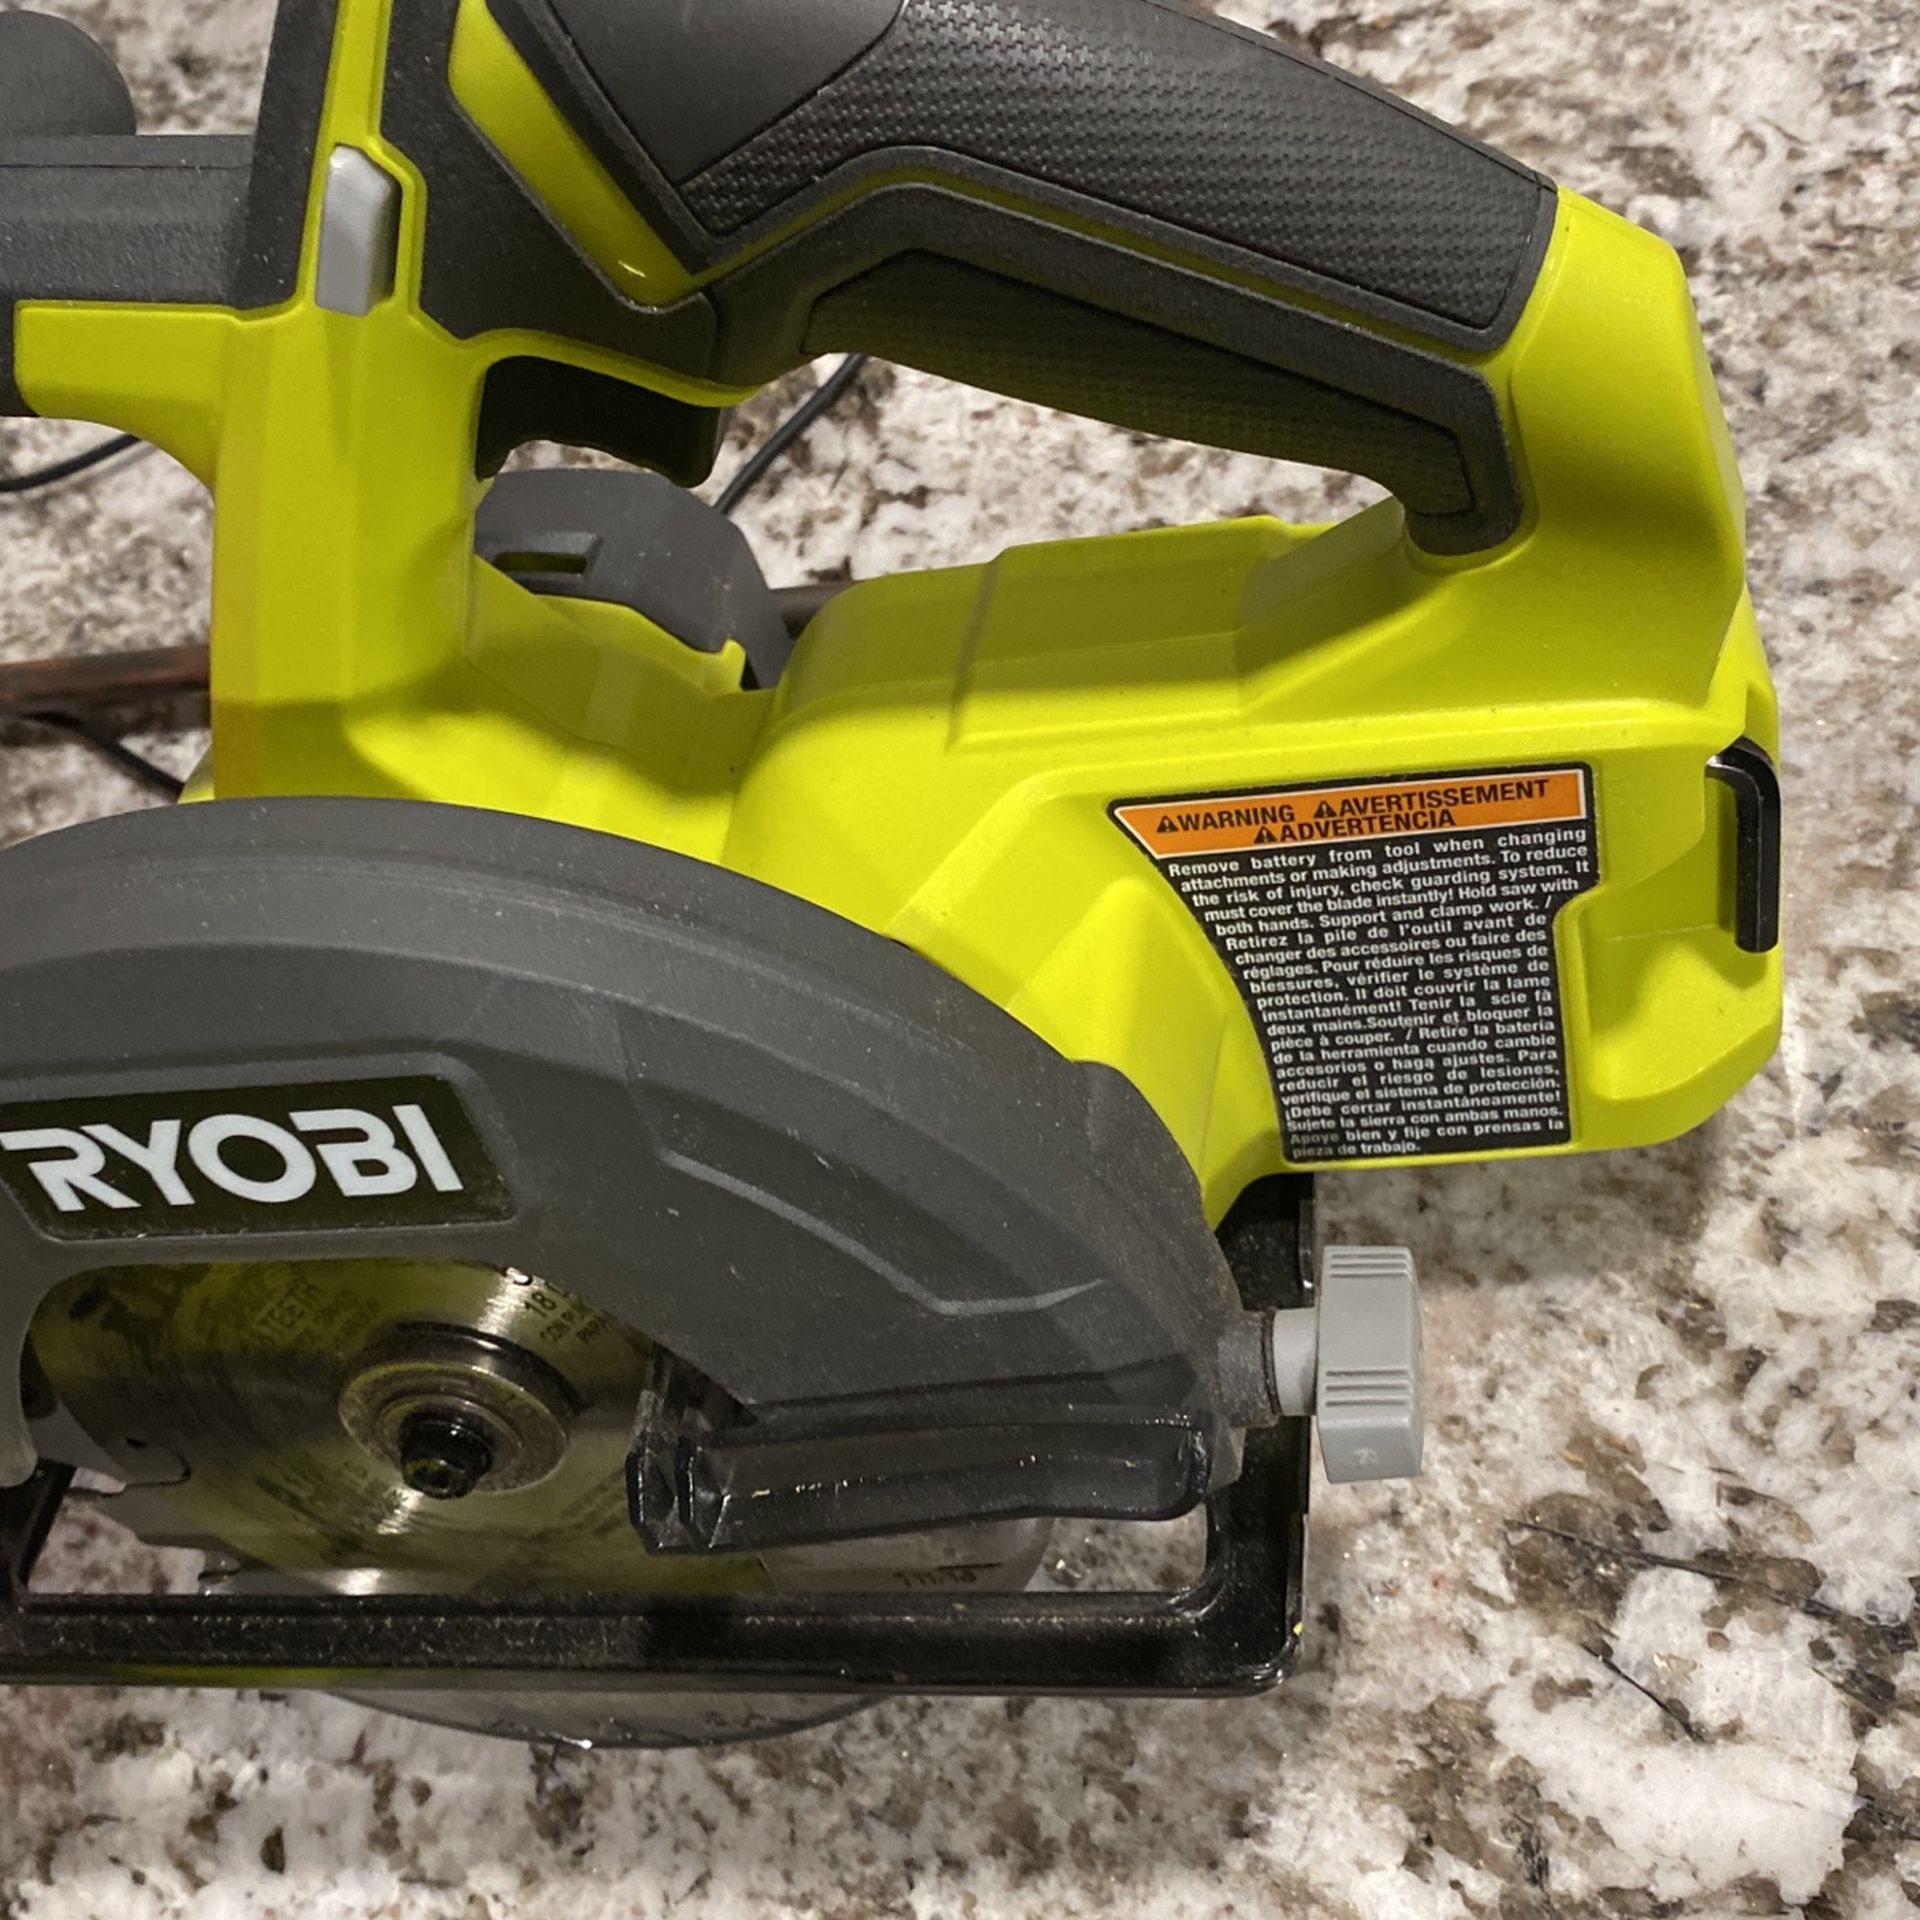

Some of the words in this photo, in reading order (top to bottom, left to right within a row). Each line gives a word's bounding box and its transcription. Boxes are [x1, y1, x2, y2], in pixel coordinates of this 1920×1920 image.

[1177, 804, 1295, 831] WARNING
[1339, 779, 1549, 817] AVERTISSEMENT
[1280, 809, 1456, 842] ADVERTENCIA
[1169, 862, 1238, 876] Remove
[1251, 855, 1315, 869] battery
[1329, 850, 1372, 862] from
[1385, 844, 1419, 857] tool
[1433, 840, 1483, 853] when
[1497, 831, 1586, 847] changing
[1180, 873, 1286, 891] attachments
[1289, 872, 1307, 882] or
[1312, 866, 1377, 880] making
[1382, 855, 1495, 875] adjustments.
[1501, 852, 1520, 863] To
[1525, 848, 1587, 861] reduce
[1191, 894, 1220, 906] the
[1225, 890, 1260, 904] risk
[1265, 888, 1283, 900] of
[1289, 886, 1344, 899] injury,
[1350, 878, 1404, 893] check
[1410, 872, 1490, 890] guarding
[1497, 866, 1569, 882] system.
[1575, 862, 1589, 873] It
[1204, 907, 1246, 921] must
[1248, 905, 1293, 917] cover
[1296, 901, 1323, 913] the
[1326, 897, 1372, 911] blade
[1376, 889, 1453, 906] instantly!
[1458, 886, 1497, 899] Hold
[1500, 885, 1536, 896] saw
[1540, 879, 1578, 893] with
[1215, 922, 1253, 936] both
[1258, 919, 1314, 932] hands.
[1319, 911, 1386, 928] Support
[1392, 908, 1424, 921] and
[1430, 905, 1483, 918] clamp
[1490, 897, 1539, 913] work.
[1225, 937, 1288, 950] Retirez
[1297, 933, 1315, 944] la
[1323, 930, 1357, 945] pile
[1366, 927, 1389, 939] de
[1398, 921, 1452, 936] l'outil
[1462, 916, 1514, 931] avant
[1524, 914, 1547, 926] de
[1234, 951, 1302, 965] changer
[1305, 948, 1337, 959] des
[1340, 940, 1441, 956] accessoires
[1444, 938, 1467, 948] ou
[1470, 933, 1510, 946] faire
[1514, 931, 1547, 942] des
[1242, 965, 1318, 980] réglages.
[1321, 961, 1360, 973] Pour
[1364, 956, 1424, 969] réduire
[1429, 953, 1454, 965] les
[1458, 950, 1522, 963] risques
[1526, 946, 1548, 957] de
[1249, 979, 1339, 993] blessures,
[1345, 972, 1409, 986] vérifier
[1418, 969, 1435, 980] le
[1442, 964, 1518, 980] système
[1526, 961, 1549, 972] de
[1256, 991, 1349, 1008] protection.
[1413, 982, 1476, 996] couvrir
[1483, 980, 1500, 991] la
[1506, 978, 1551, 990] lame
[1261, 1001, 1401, 1022] instantanément!
[1409, 998, 1452, 1011] Tenir
[1459, 996, 1476, 1007] la
[1490, 992, 1527, 1005] scie
[1266, 1024, 1306, 1035] deux
[1442, 1011, 1460, 1023] et
[1466, 1009, 1530, 1022] bloquer
[1537, 1005, 1553, 1017] la
[1270, 1037, 1313, 1051] pièce
[1319, 1034, 1329, 1046] à
[1334, 1033, 1394, 1046] couper.
[1418, 1027, 1468, 1039] Retire
[1473, 1025, 1489, 1036] la
[1272, 1053, 1293, 1064] de
[1299, 1051, 1315, 1062] la
[1320, 1044, 1420, 1061] herramienta
[1426, 1039, 1488, 1053] cuando
[1494, 1034, 1556, 1048] cambie
[1275, 1062, 1367, 1078] accesorios
[1373, 1062, 1385, 1071] o
[1441, 1053, 1510, 1068] ajustes.
[1517, 1050, 1558, 1061] Para
[1278, 1077, 1339, 1091] reducir
[1351, 1075, 1368, 1086] el
[1379, 1073, 1434, 1085] riesgo
[1446, 1069, 1468, 1080] de
[1480, 1065, 1559, 1078] lesiones,
[1281, 1091, 1350, 1105] verifique
[1355, 1089, 1370, 1100] el
[1374, 1086, 1438, 1099] sistema
[1443, 1083, 1463, 1094] de
[1468, 1077, 1560, 1095] protección.
[1400, 1091, 1560, 1111] instantáneamente!
[1286, 1118, 1336, 1132] Sujete
[1339, 1117, 1355, 1128] la
[1359, 1115, 1405, 1127] sierra
[1409, 1114, 1440, 1124] con
[1444, 1109, 1499, 1122] ambas
[1503, 1108, 1563, 1118] manos.
[1345, 1129, 1381, 1141] bien
[1387, 1130, 1397, 1141] y
[1403, 1126, 1430, 1140] fije
[1436, 1126, 1468, 1136] con
[1473, 1122, 1542, 1137] prensas
[1548, 1119, 1564, 1130] la
[1, 1103, 463, 1213] RYOBI
[1337, 1144, 1356, 1155] de
[1359, 1141, 1420, 1155] trabajo.
[524, 1291, 557, 1317] 18
